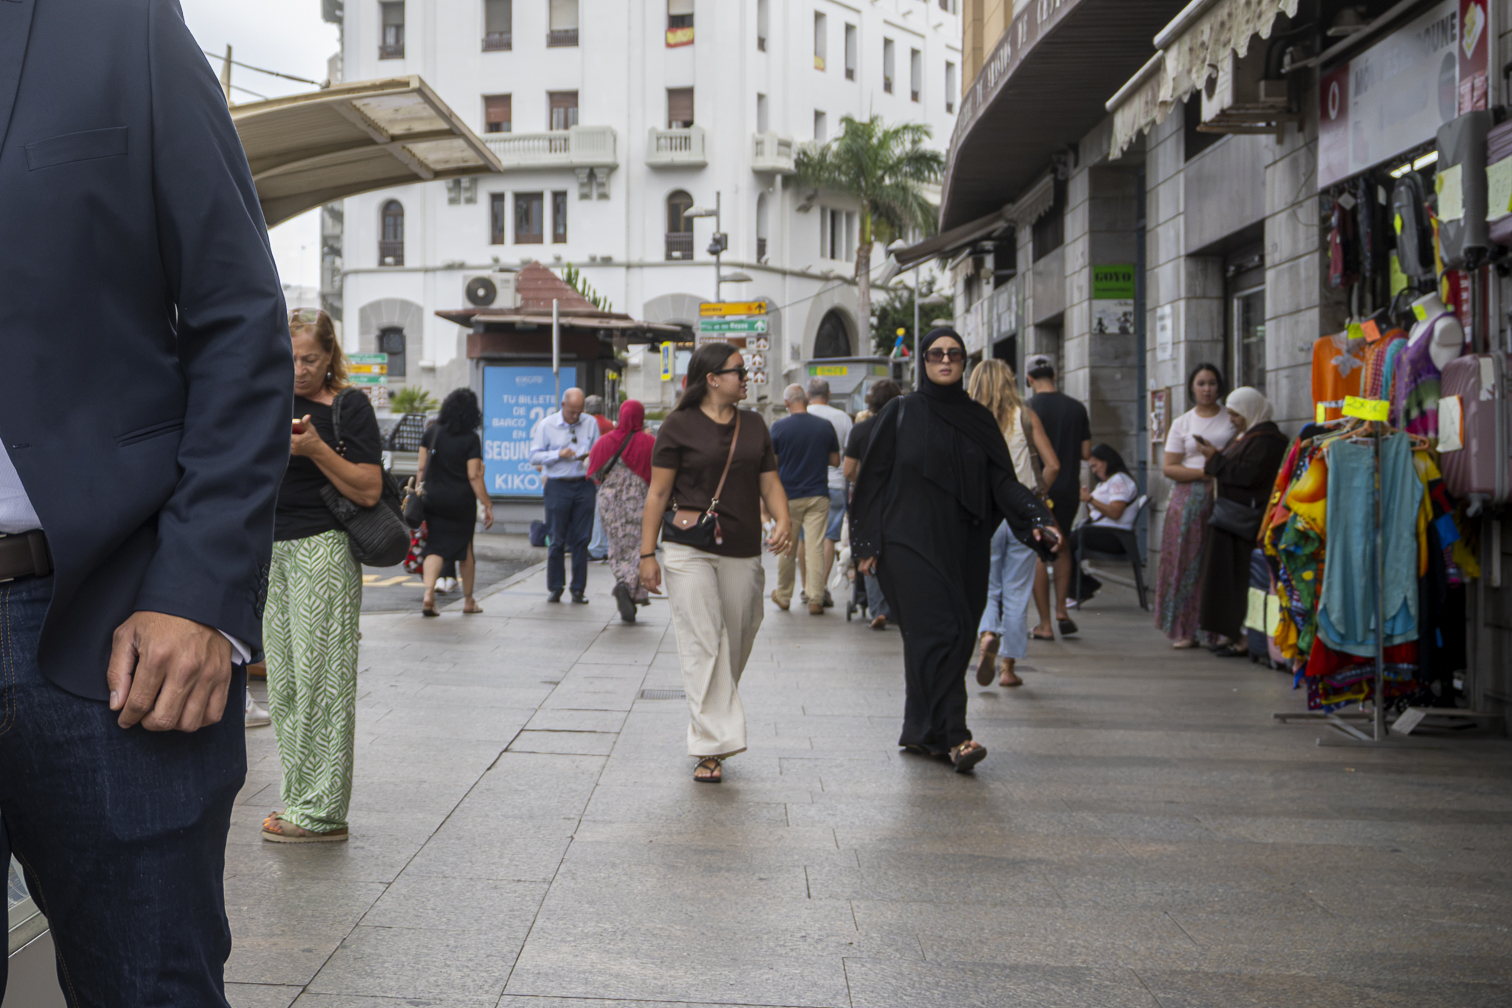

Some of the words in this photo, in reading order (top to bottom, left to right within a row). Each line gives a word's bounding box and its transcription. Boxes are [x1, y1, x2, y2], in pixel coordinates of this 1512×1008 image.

[502, 394, 516, 404] TU
[512, 406, 526, 416] DE
[492, 418, 526, 428] BARCO
[512, 430, 526, 439] EN
[485, 440, 531, 460] SEGUN
[495, 474, 544, 490] KIKO
